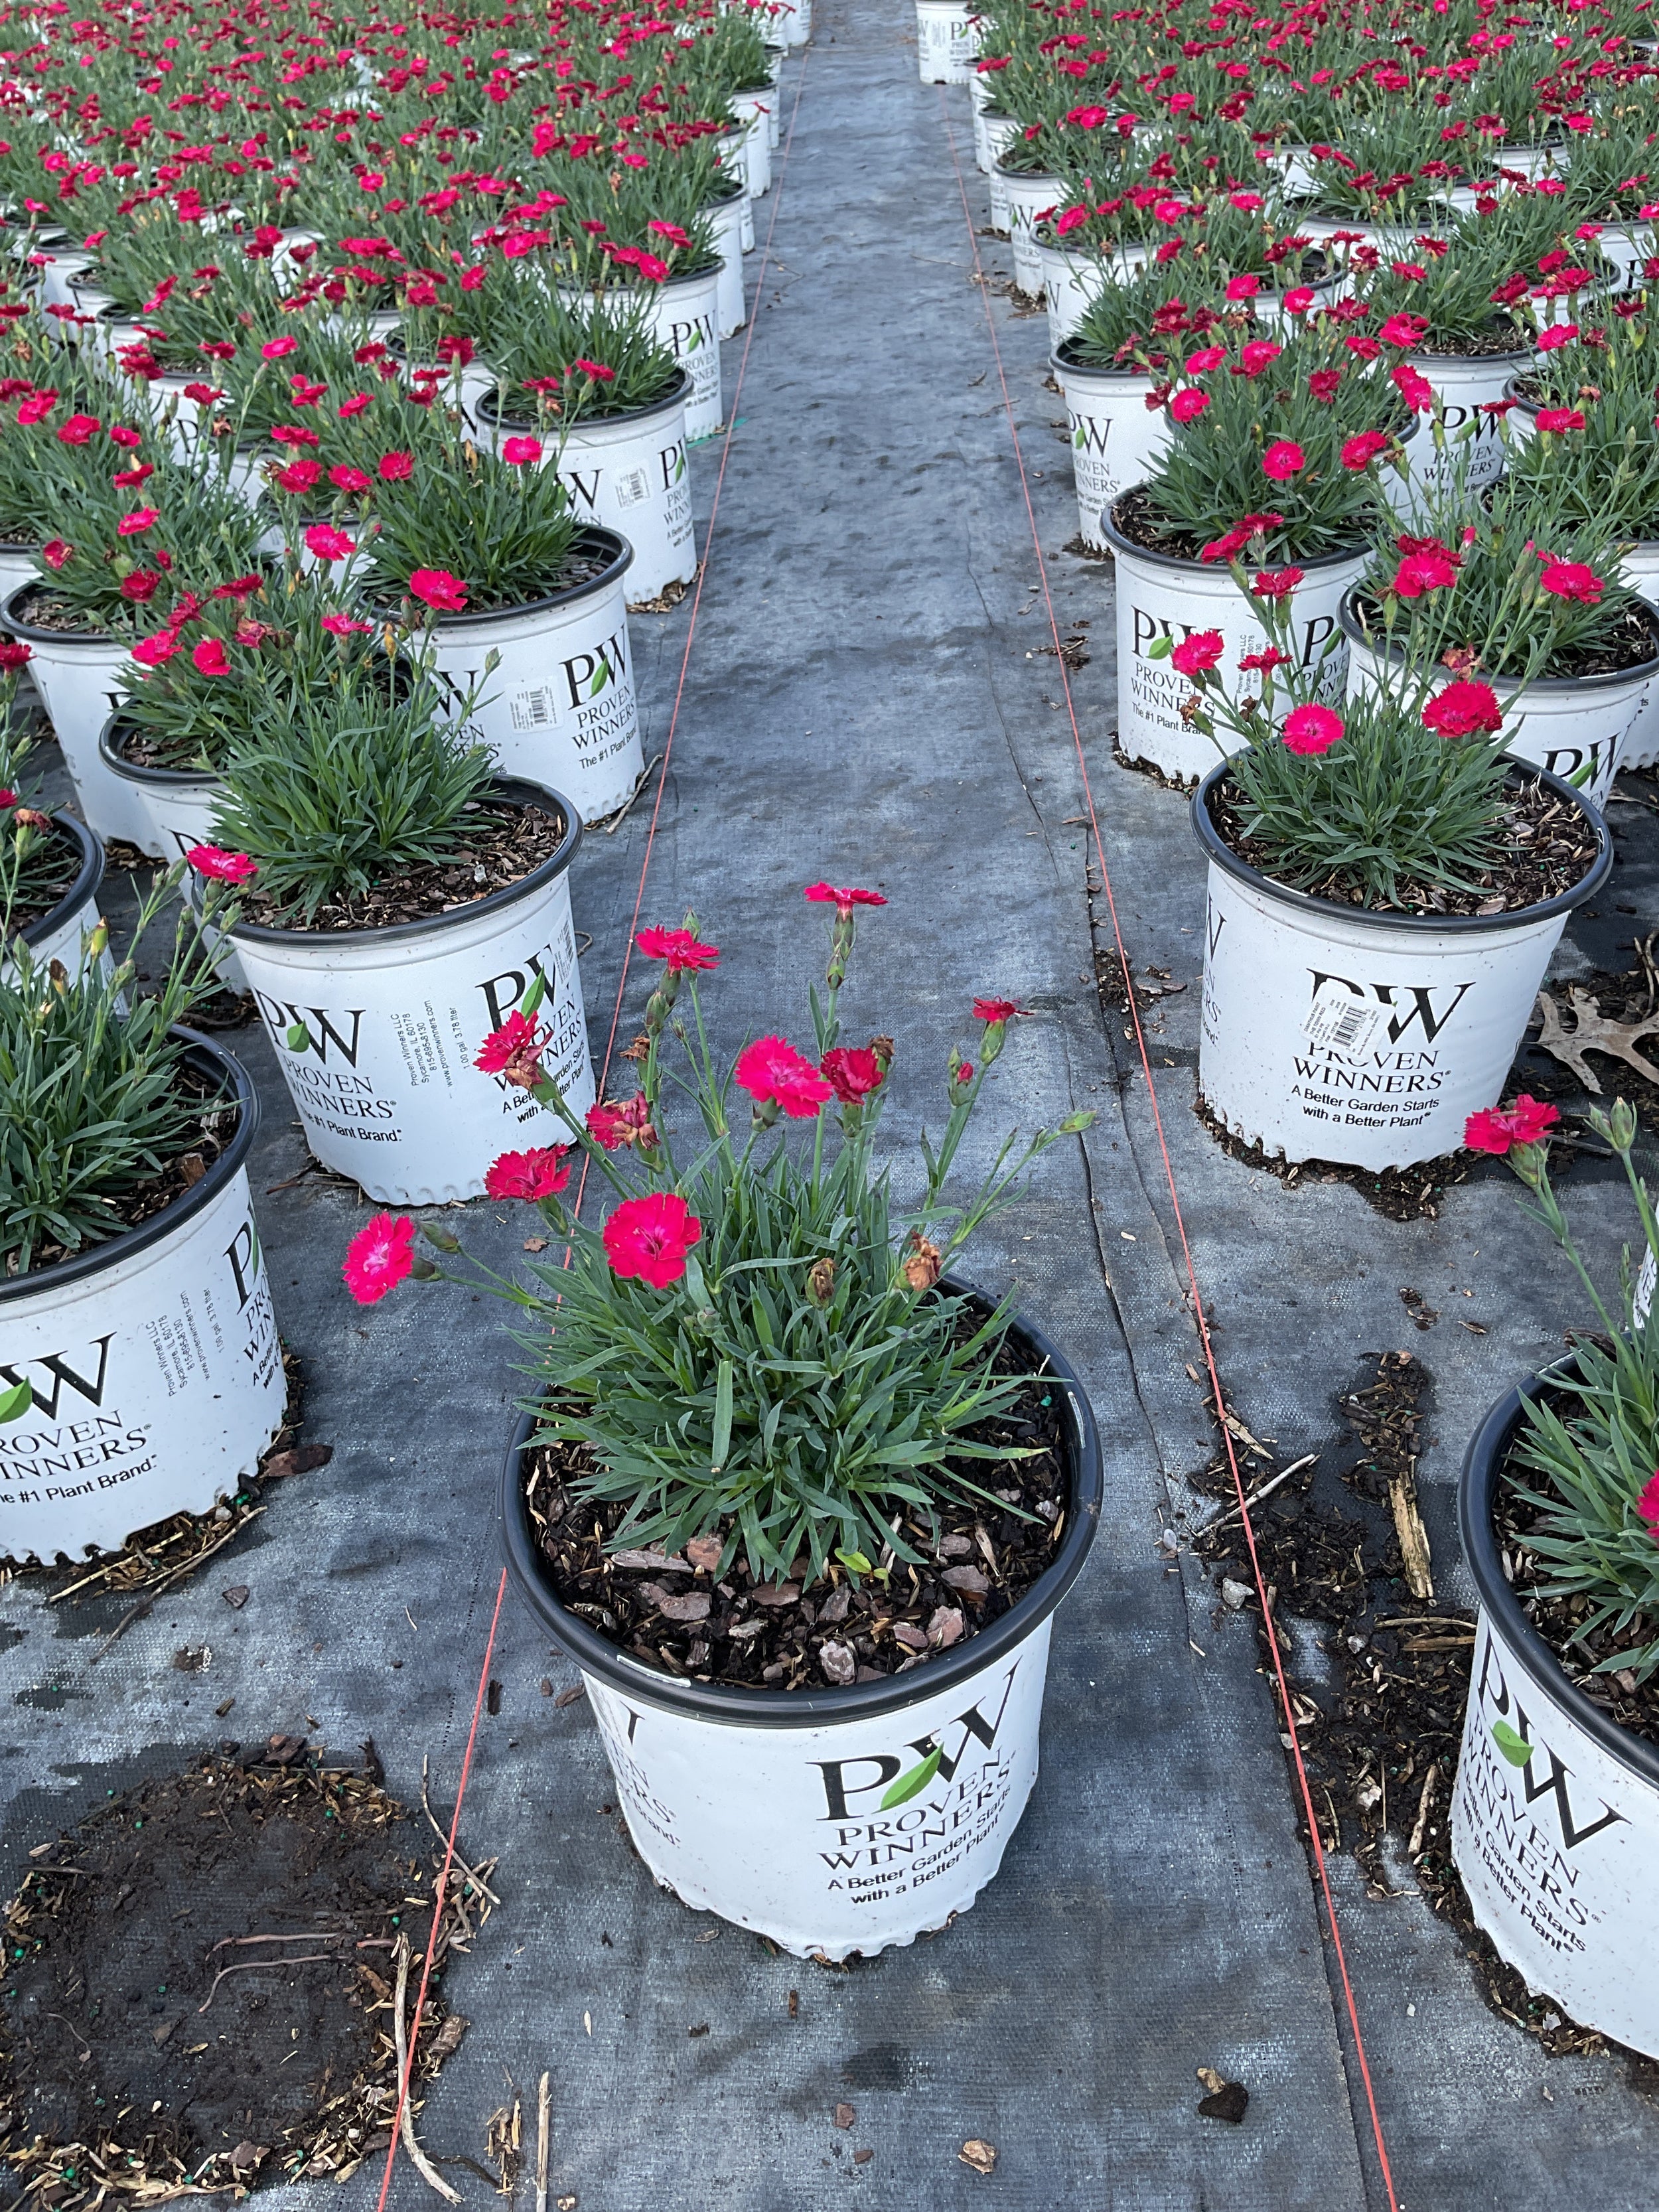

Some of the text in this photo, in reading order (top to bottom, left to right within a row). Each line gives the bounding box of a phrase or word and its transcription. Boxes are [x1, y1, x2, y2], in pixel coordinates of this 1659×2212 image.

[669, 309, 715, 356] PW
[559, 623, 625, 710] PW
[1135, 661, 1196, 696] PROVE
[577, 681, 630, 729] PROVEN
[1131, 677, 1216, 717] WINNES
[1132, 701, 1144, 719] The
[1145, 709, 1155, 723] #1
[1157, 715, 1179, 731] Plant
[579, 755, 597, 769] The
[599, 747, 609, 762] #1
[611, 739, 626, 756] Plant
[251, 985, 367, 1069] PW
[390, 1013, 419, 1086] Proven Winners LLC
[402, 1013, 430, 1084] Sycamore, IL 60178
[424, 1000, 453, 1088] www.provenwinners.com
[457, 1041, 469, 1053] gal
[283, 1055, 374, 1095] PROVEN
[1291, 1084, 1439, 1112] A Better Garden Starts
[1293, 1056, 1444, 1093] WINNERS
[314, 1115, 326, 1128] #1
[327, 1120, 357, 1140] Plant
[502, 1100, 512, 1115] A
[517, 1104, 538, 1124] with
[1303, 1106, 1423, 1128] with a Better Plant
[158, 1314, 173, 1341] 60178
[212, 1322, 222, 1335] gal
[145, 1320, 177, 1397] Proven Winners LLC
[253, 1370, 259, 1386] A
[19, 1491, 40, 1503] #1
[46, 1481, 96, 1501] Plant
[805, 1655, 1023, 1821] PW
[1477, 1630, 1632, 1850] PW
[817, 1759, 1010, 1870] WINNERS
[833, 1745, 1003, 1846] PROVEN
[1474, 1712, 1583, 1889] PROVEN
[828, 1784, 1011, 1890] A Better Garden Starts
[1468, 1714, 1589, 1926] WINNERS
[851, 1814, 1000, 1904] with a Better Plant
[1482, 1846, 1518, 1904] Better
[1520, 1903, 1563, 1953] Plant
[1486, 1830, 1532, 1901] Garden
[1535, 1899, 1586, 1953] Starts
